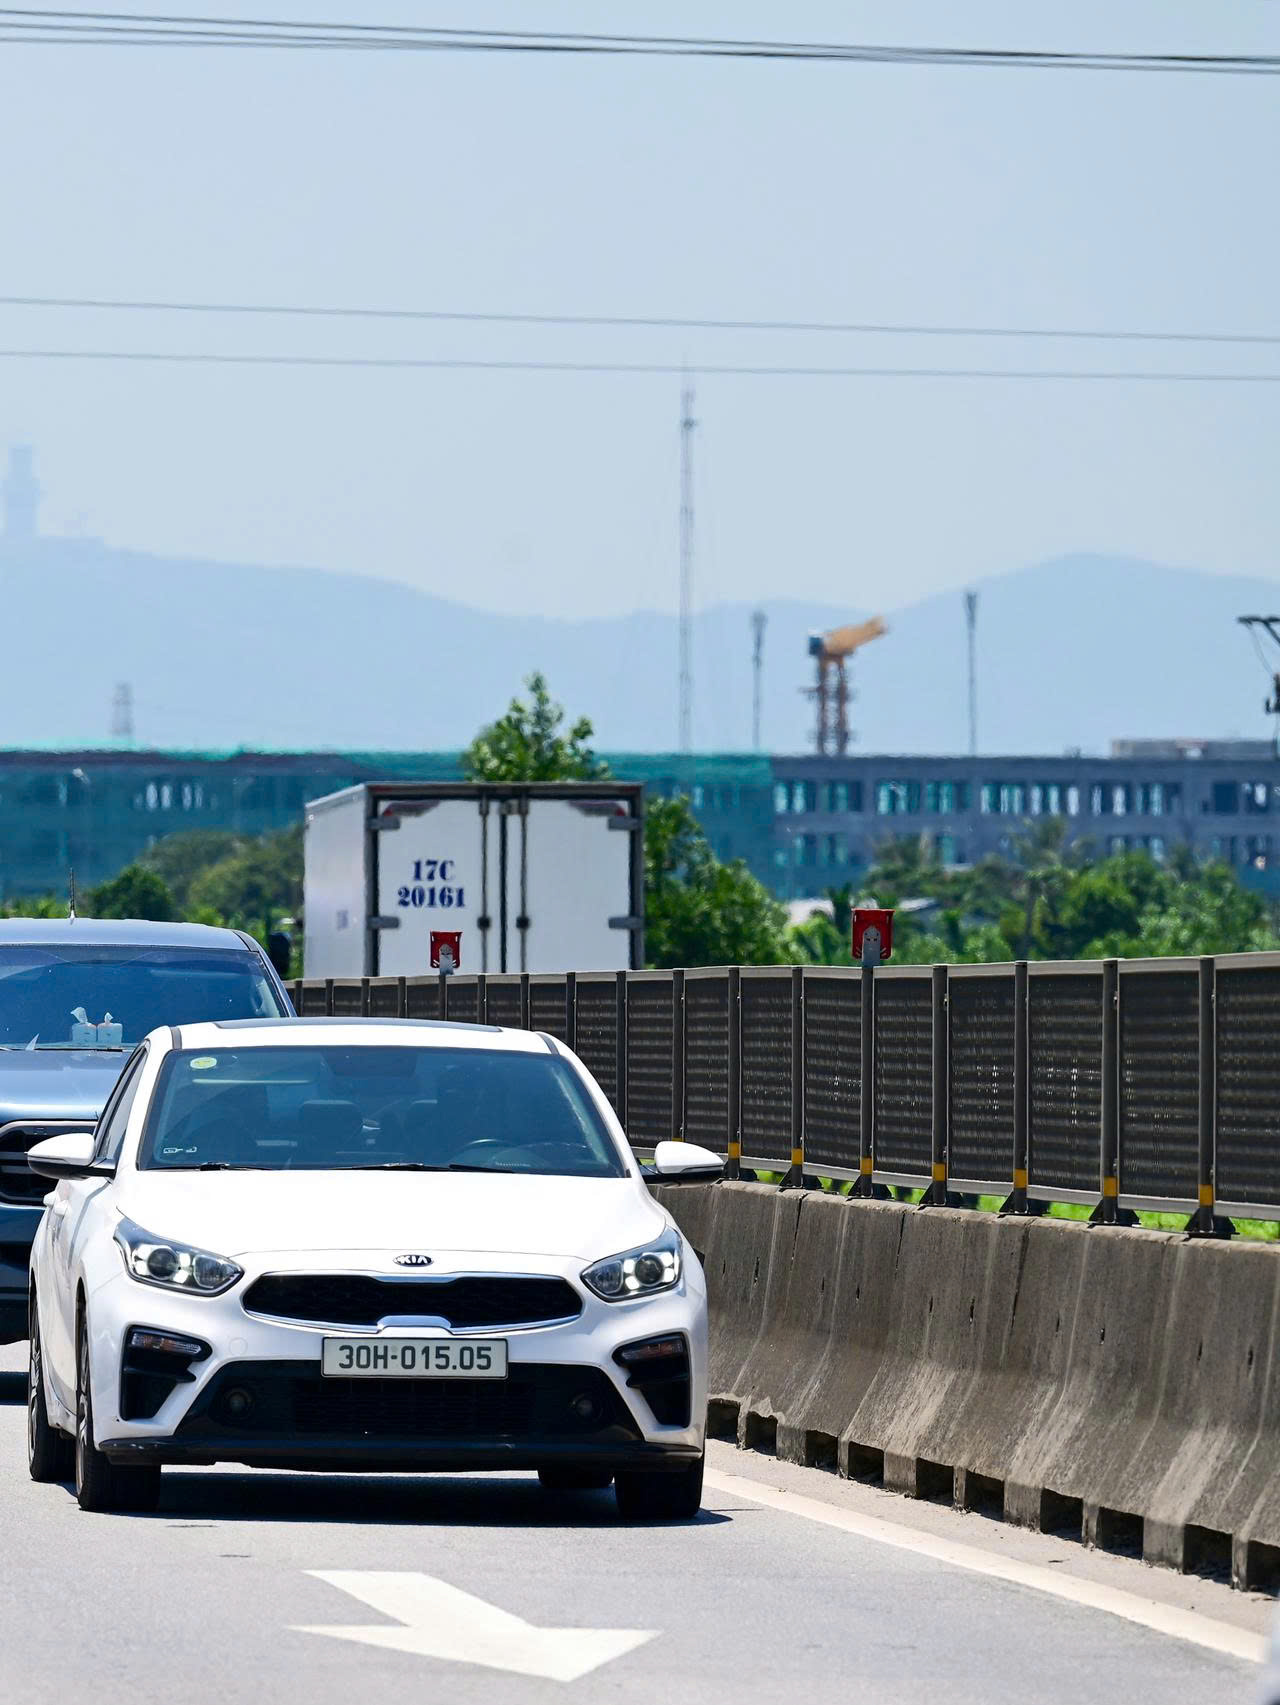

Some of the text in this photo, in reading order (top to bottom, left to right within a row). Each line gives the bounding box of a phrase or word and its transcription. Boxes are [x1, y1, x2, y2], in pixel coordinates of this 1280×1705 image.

[413, 859, 455, 881] 17C
[397, 886, 466, 907] 20161
[396, 1255, 429, 1265] KIA
[338, 1345, 492, 1370] 30H-015.05
